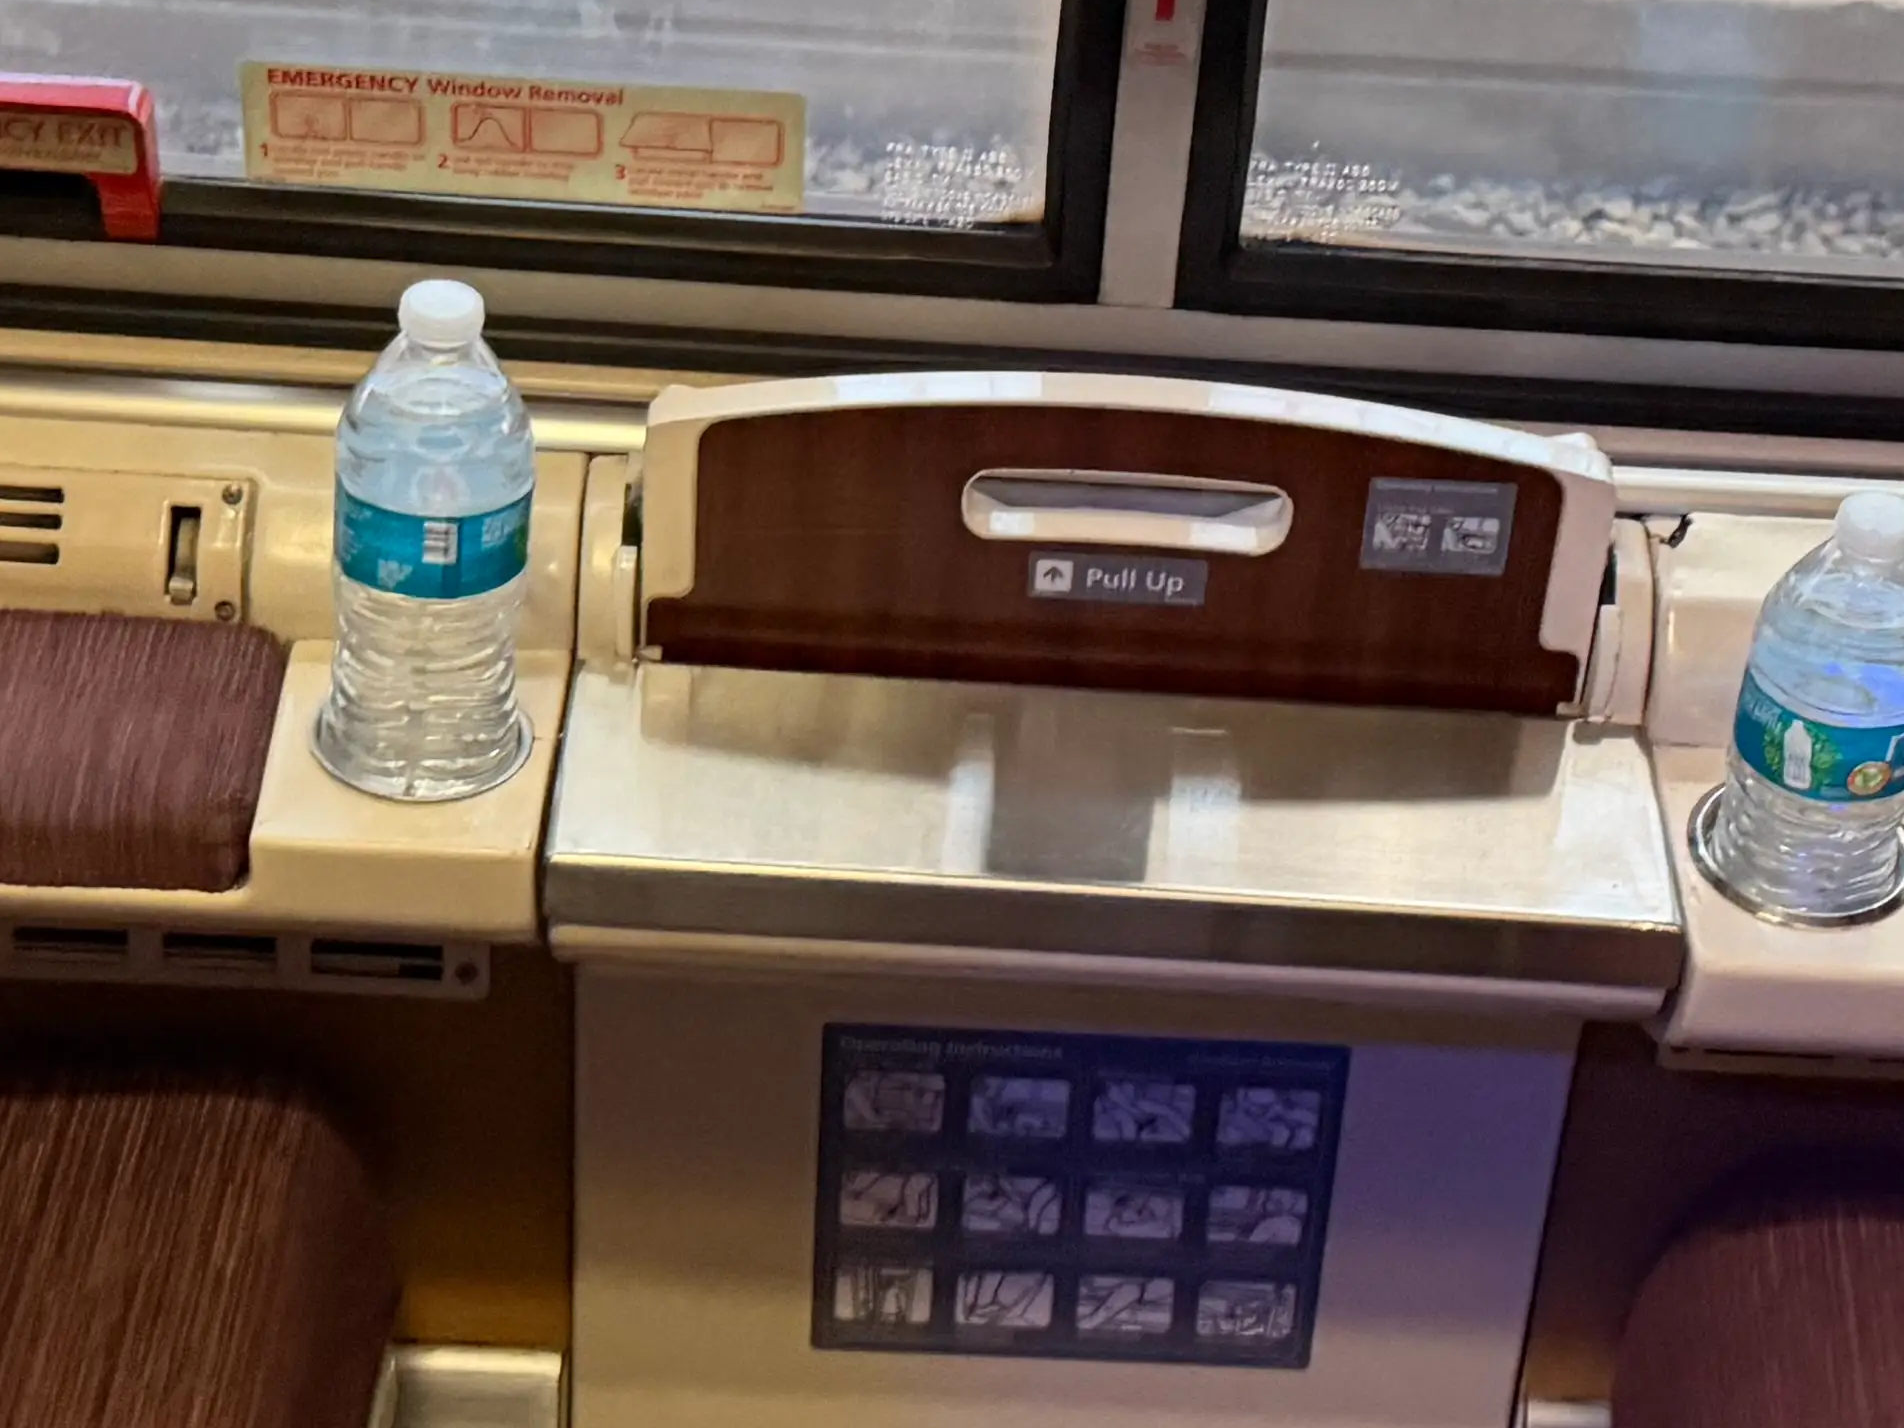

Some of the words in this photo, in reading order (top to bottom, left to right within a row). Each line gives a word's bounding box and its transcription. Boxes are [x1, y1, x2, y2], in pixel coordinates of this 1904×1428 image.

[267, 68, 419, 94] EMERGENCY
[428, 78, 523, 99] Window
[529, 85, 624, 106] Removal
[57, 121, 124, 149] EXIT
[437, 154, 449, 169] 2
[615, 164, 627, 180] 3
[1086, 567, 1137, 592] Pull
[1146, 571, 1184, 599] Up
